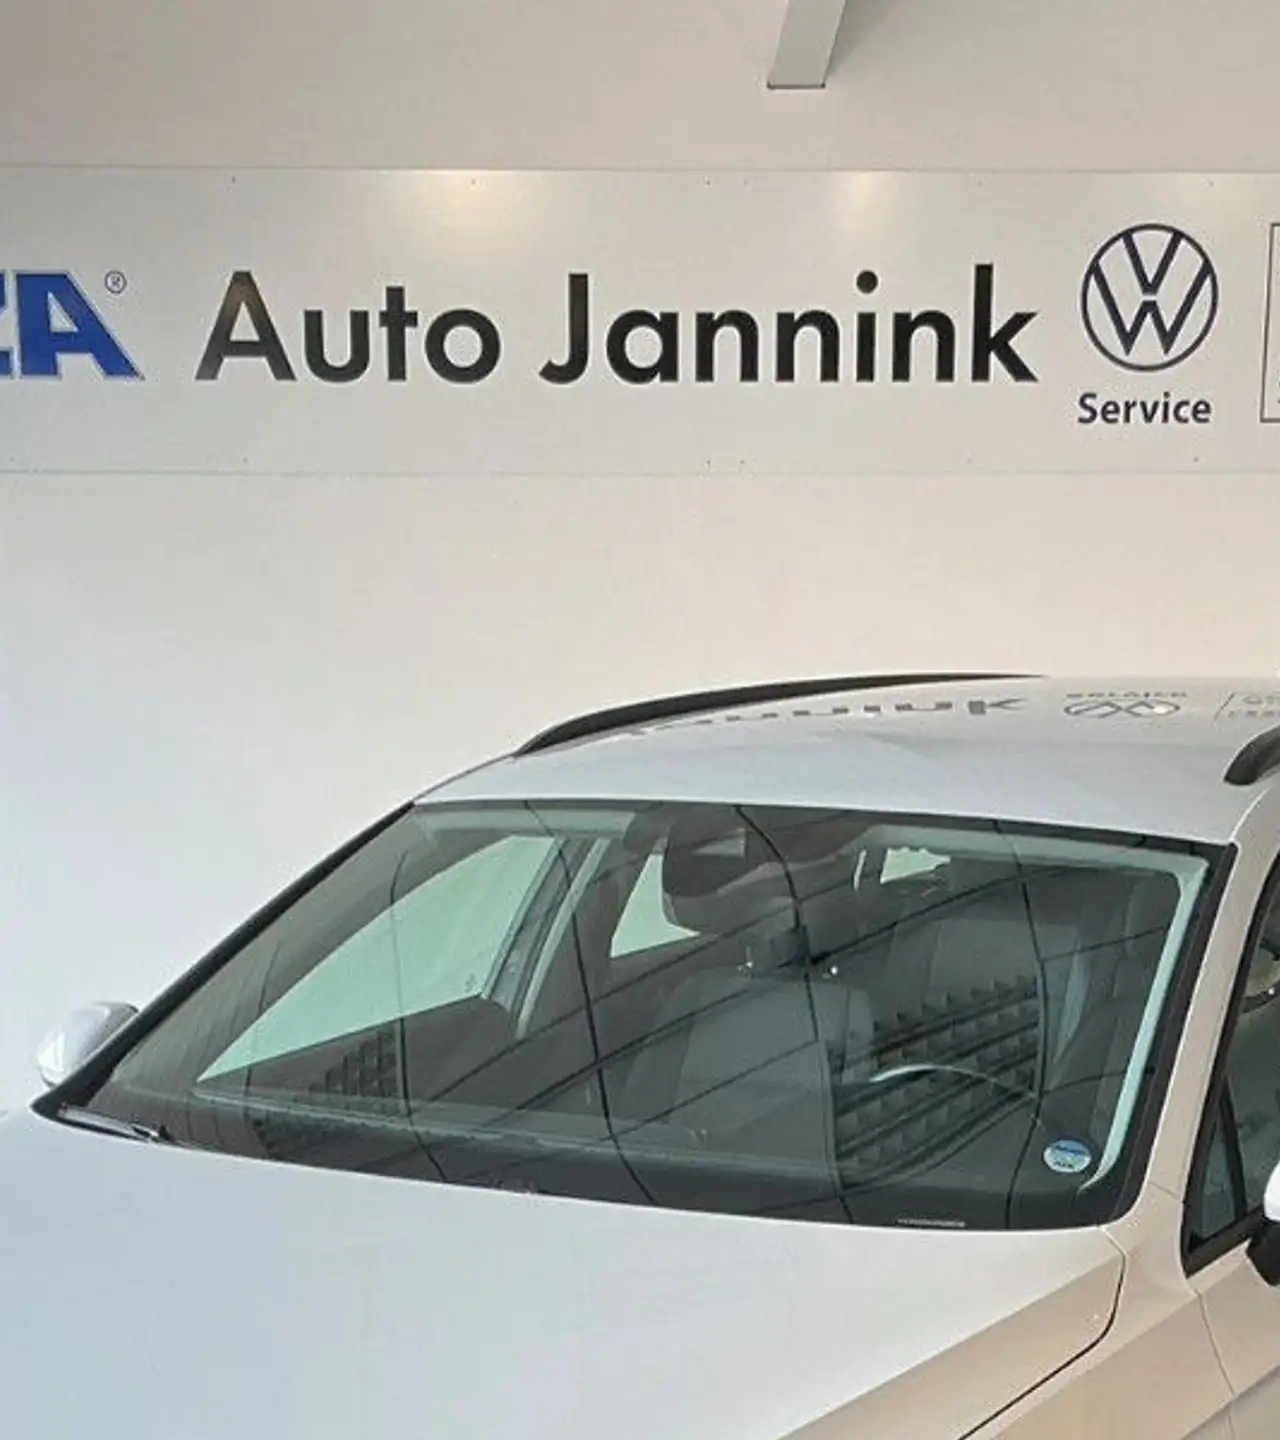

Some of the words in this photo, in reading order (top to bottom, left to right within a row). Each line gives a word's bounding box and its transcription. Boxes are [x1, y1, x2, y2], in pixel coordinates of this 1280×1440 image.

[194, 269, 502, 385] Auto
[537, 261, 1040, 385] Jannink
[1076, 390, 1213, 426] Service
